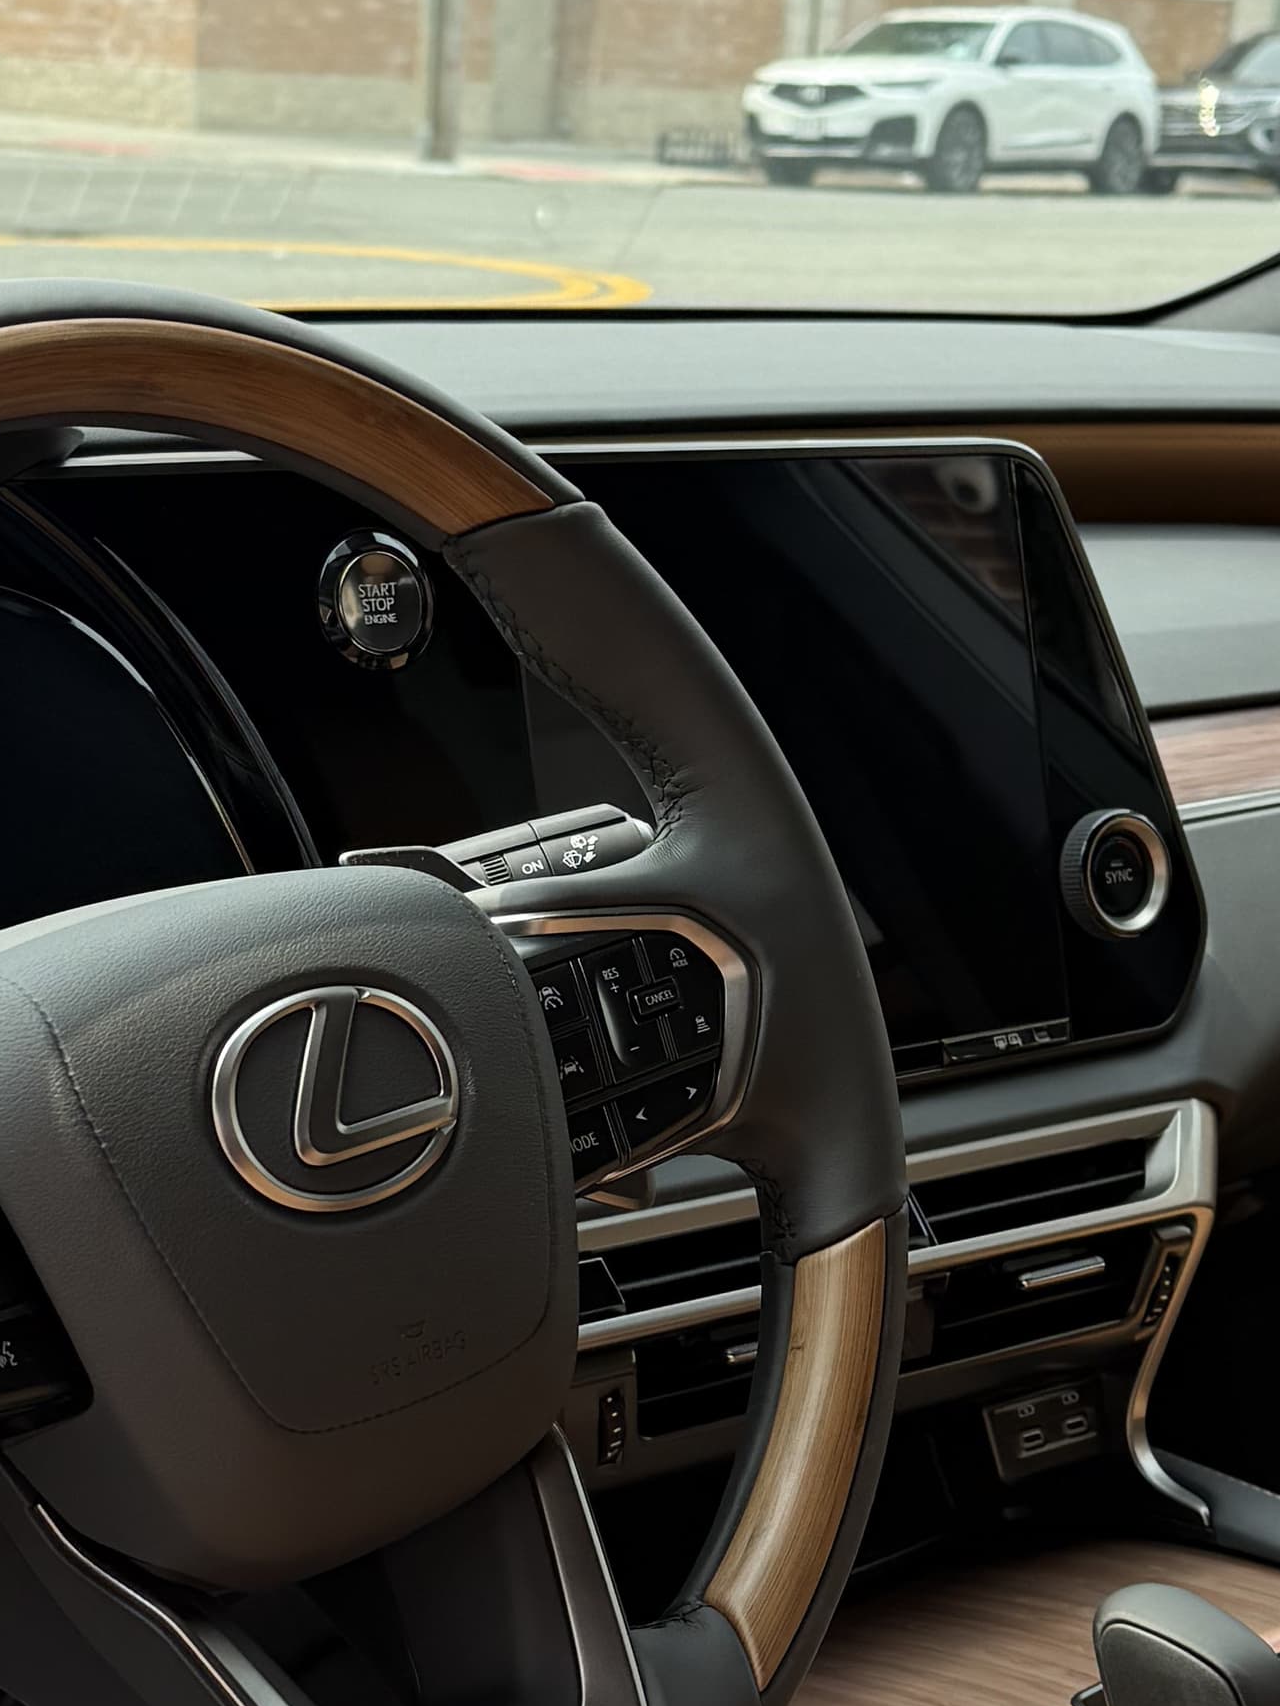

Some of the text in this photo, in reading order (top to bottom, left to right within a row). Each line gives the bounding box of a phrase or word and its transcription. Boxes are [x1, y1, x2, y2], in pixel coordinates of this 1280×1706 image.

[358, 581, 397, 598] START
[362, 596, 395, 613] STOP
[364, 612, 398, 626] ENGINE
[522, 859, 544, 875] ON
[1105, 867, 1134, 885] SYNC
[602, 967, 620, 981] RES
[645, 989, 675, 1006] CANCEL
